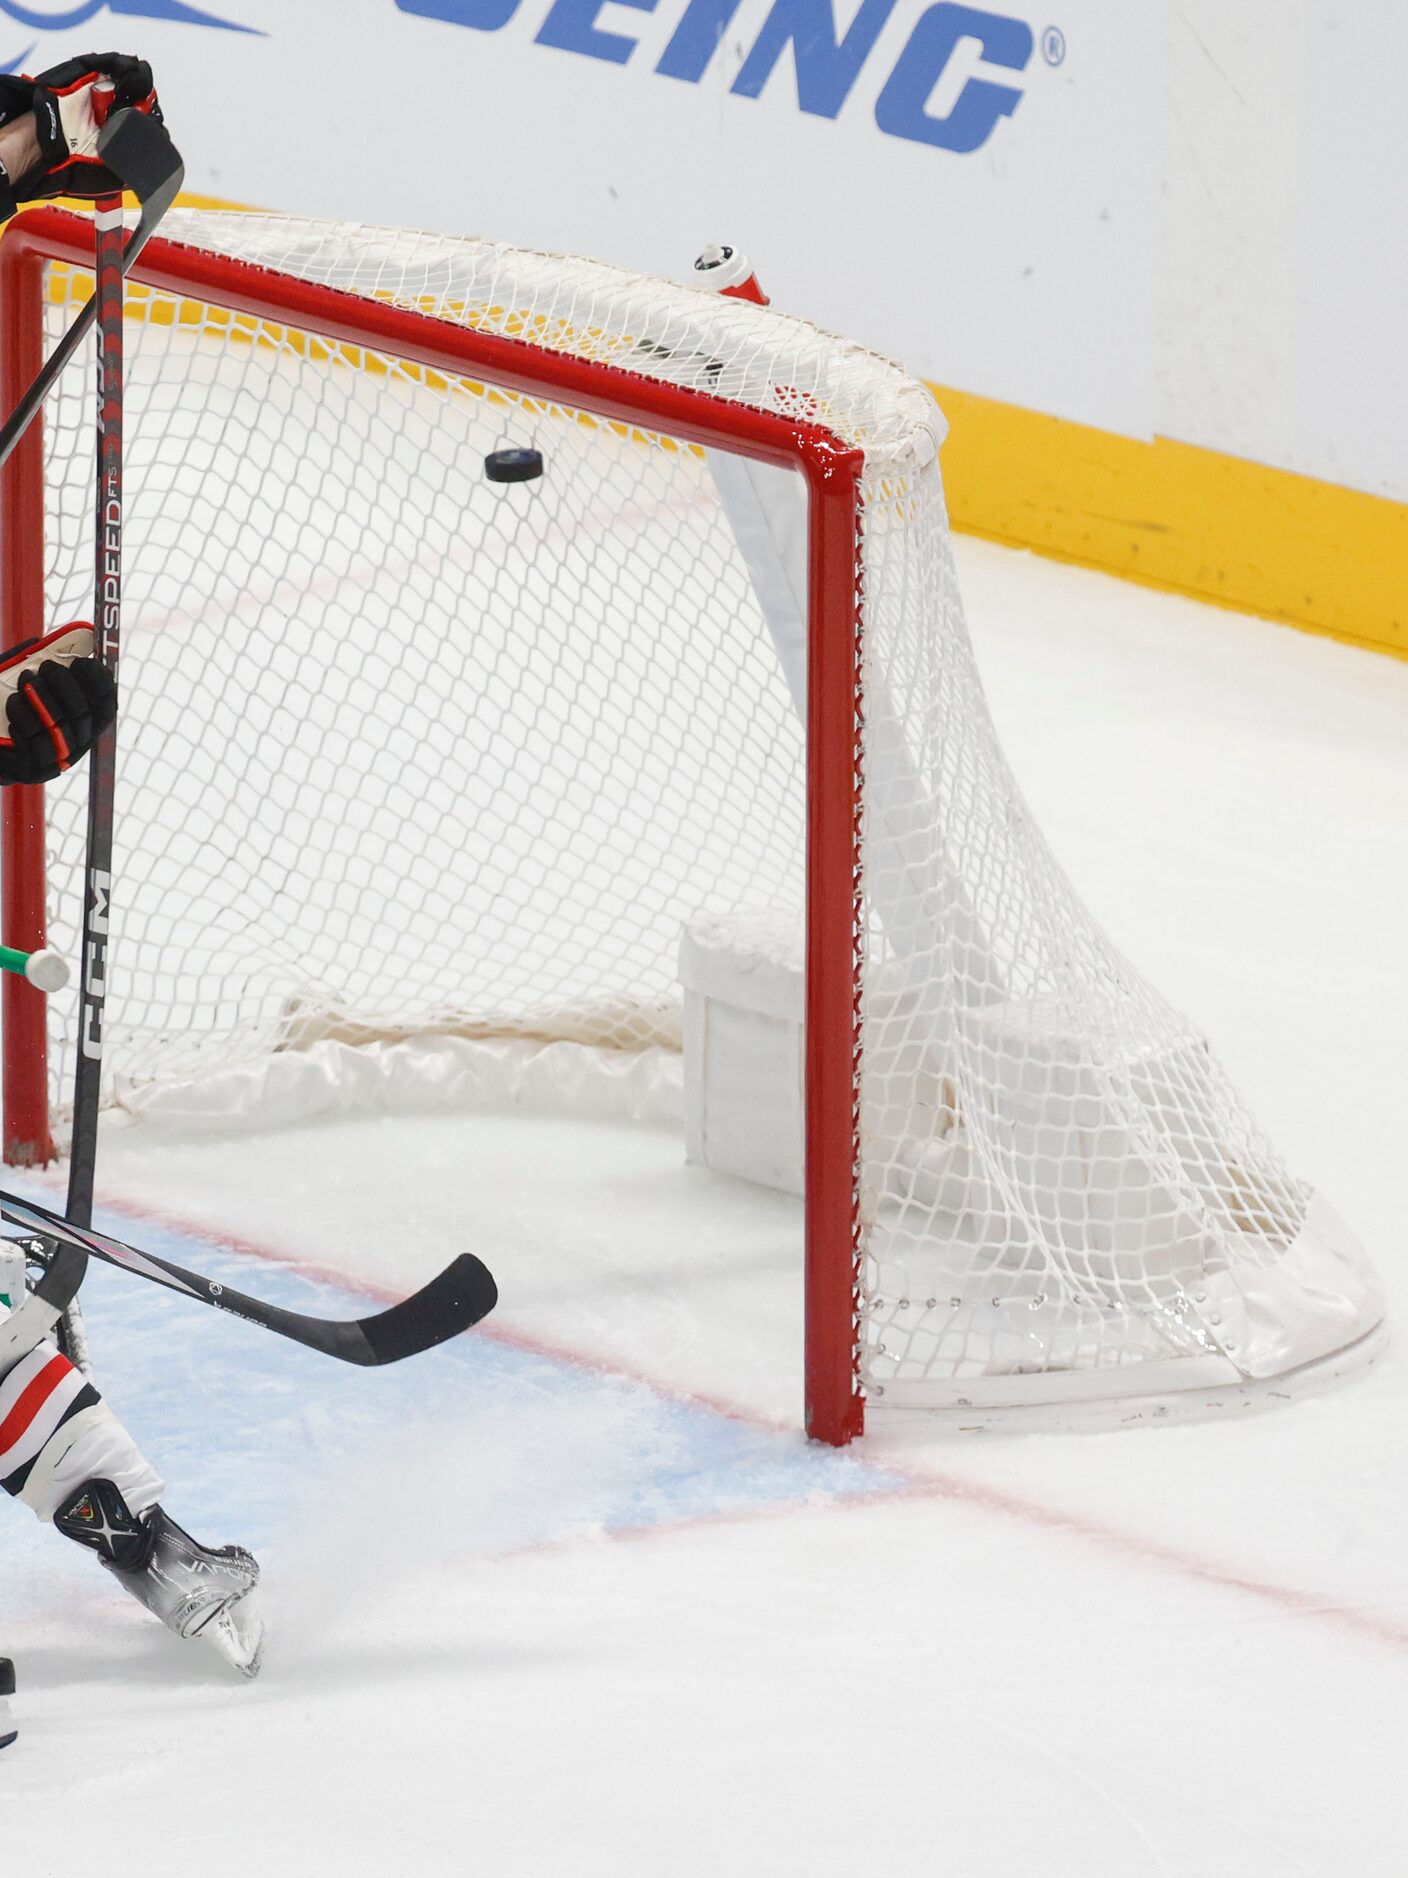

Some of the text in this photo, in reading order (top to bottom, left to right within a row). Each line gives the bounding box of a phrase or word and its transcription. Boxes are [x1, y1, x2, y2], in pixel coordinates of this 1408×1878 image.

[388, 0, 1035, 153] EING
[102, 499, 122, 684] TSPEED
[82, 867, 112, 1061] CCM
